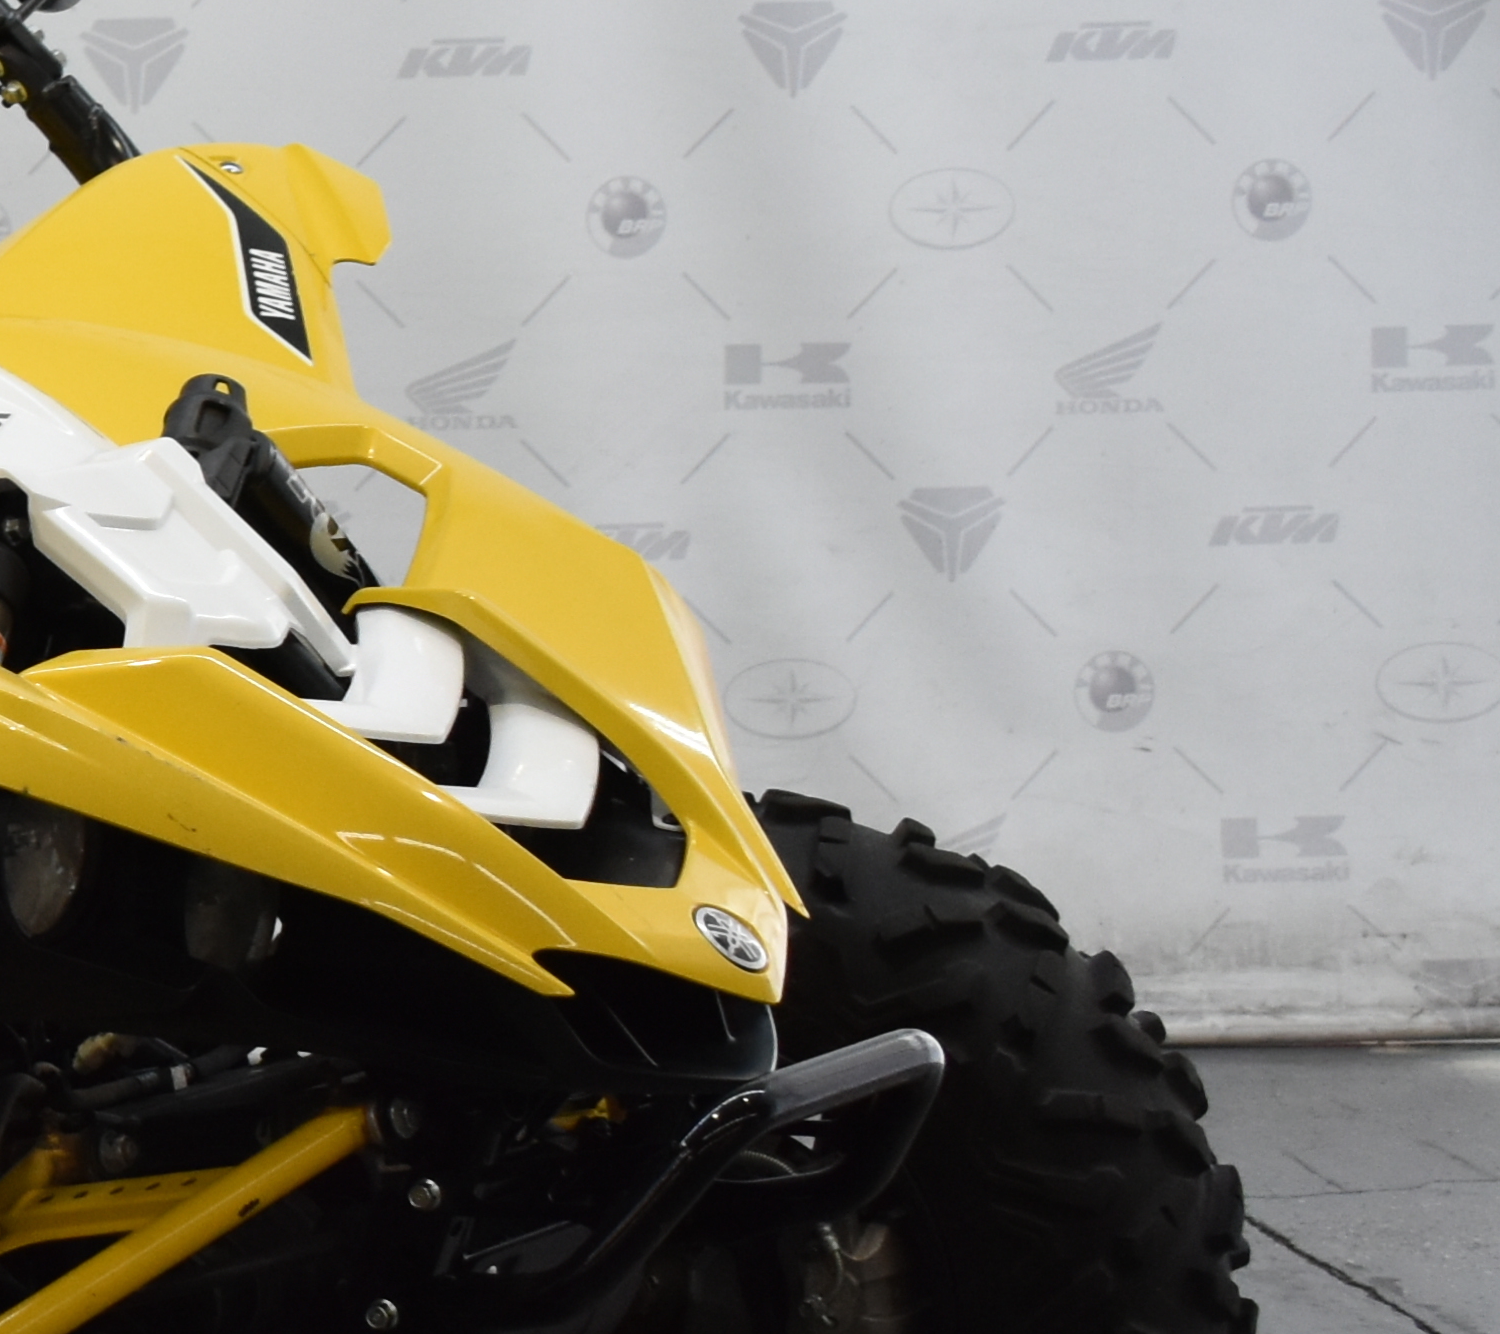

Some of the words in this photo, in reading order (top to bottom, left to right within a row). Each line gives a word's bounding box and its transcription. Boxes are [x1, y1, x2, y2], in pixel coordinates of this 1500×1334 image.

[1046, 21, 1177, 63] KTM
[396, 37, 531, 80] KTM
[1261, 201, 1311, 218] BRP
[616, 218, 666, 235] BRP
[248, 248, 296, 321] YAMAHA
[1371, 368, 1497, 393] Kawasaki
[724, 384, 851, 410] Kawasaki
[1056, 399, 1165, 416] HONDA
[1208, 505, 1340, 547] KTM
[596, 523, 691, 560] TM
[1104, 692, 1154, 709] BRP
[1222, 861, 1351, 885] Kawasaki
